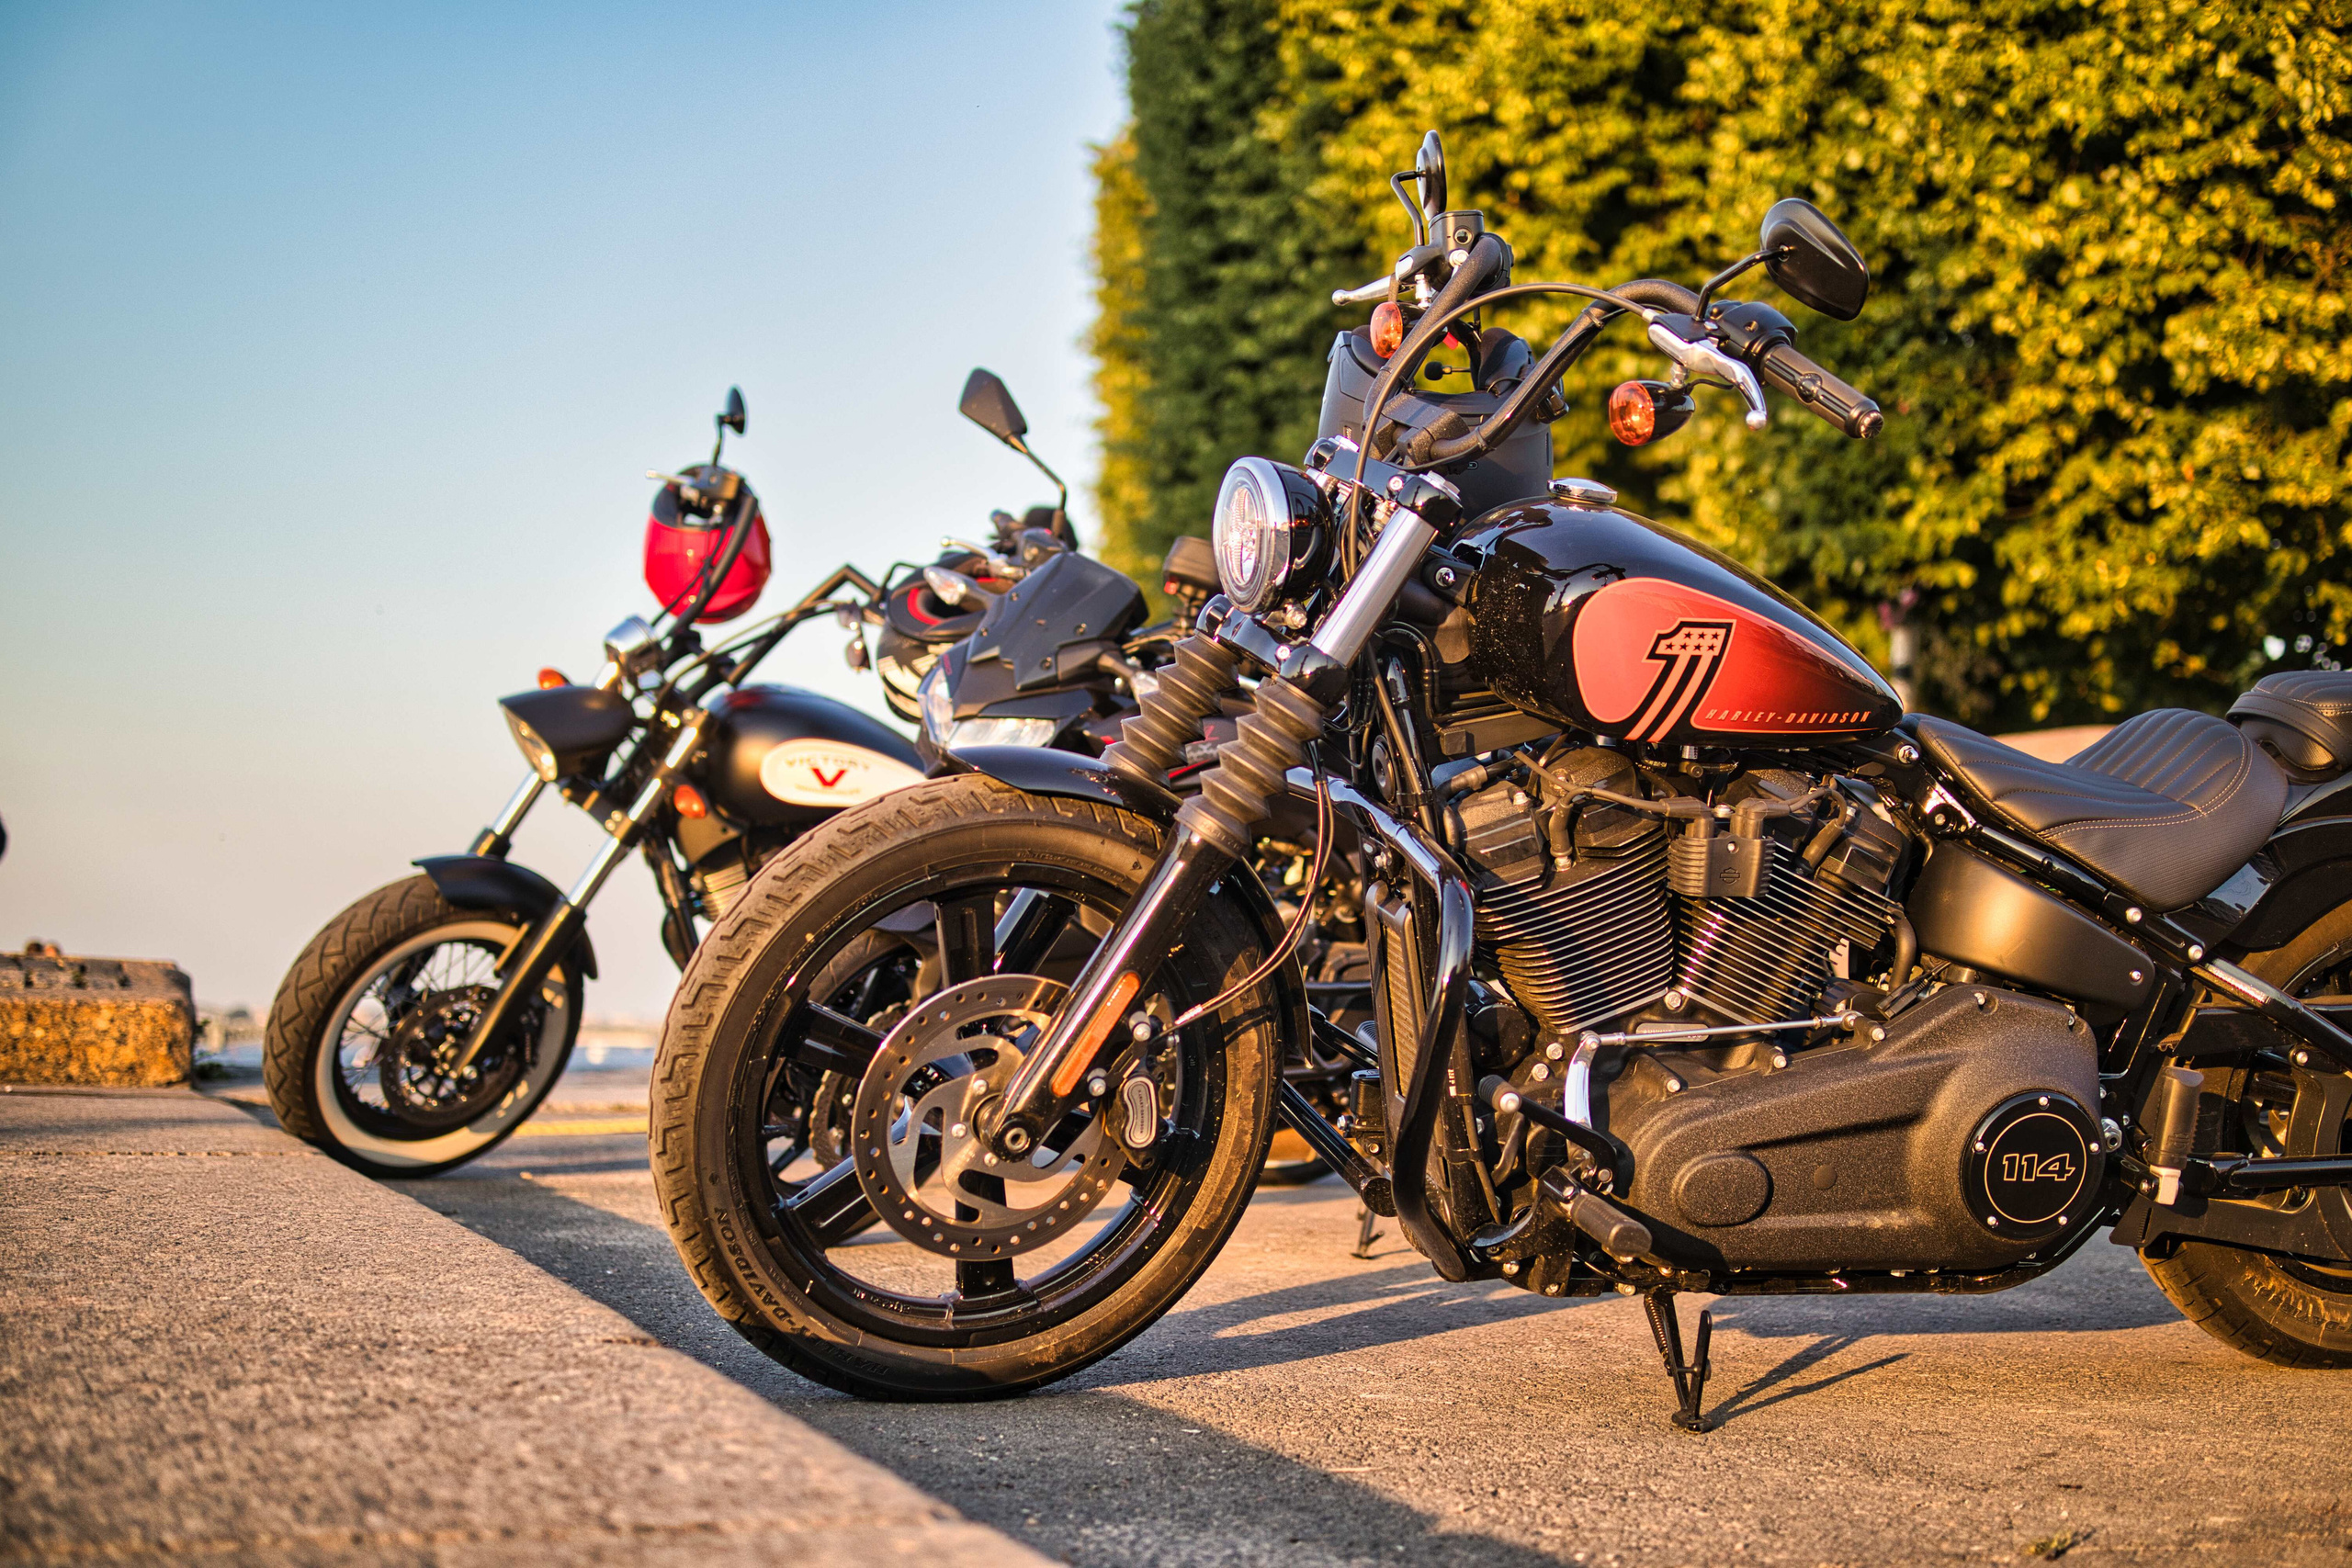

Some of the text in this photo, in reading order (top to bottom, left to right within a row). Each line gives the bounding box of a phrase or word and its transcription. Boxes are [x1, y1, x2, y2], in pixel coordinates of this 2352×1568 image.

[1705, 708, 1871, 724] HARLEY-DAVIDSON
[785, 755, 869, 772] VICTORY
[809, 768, 848, 787] V
[2003, 1153, 2075, 1182] 114
